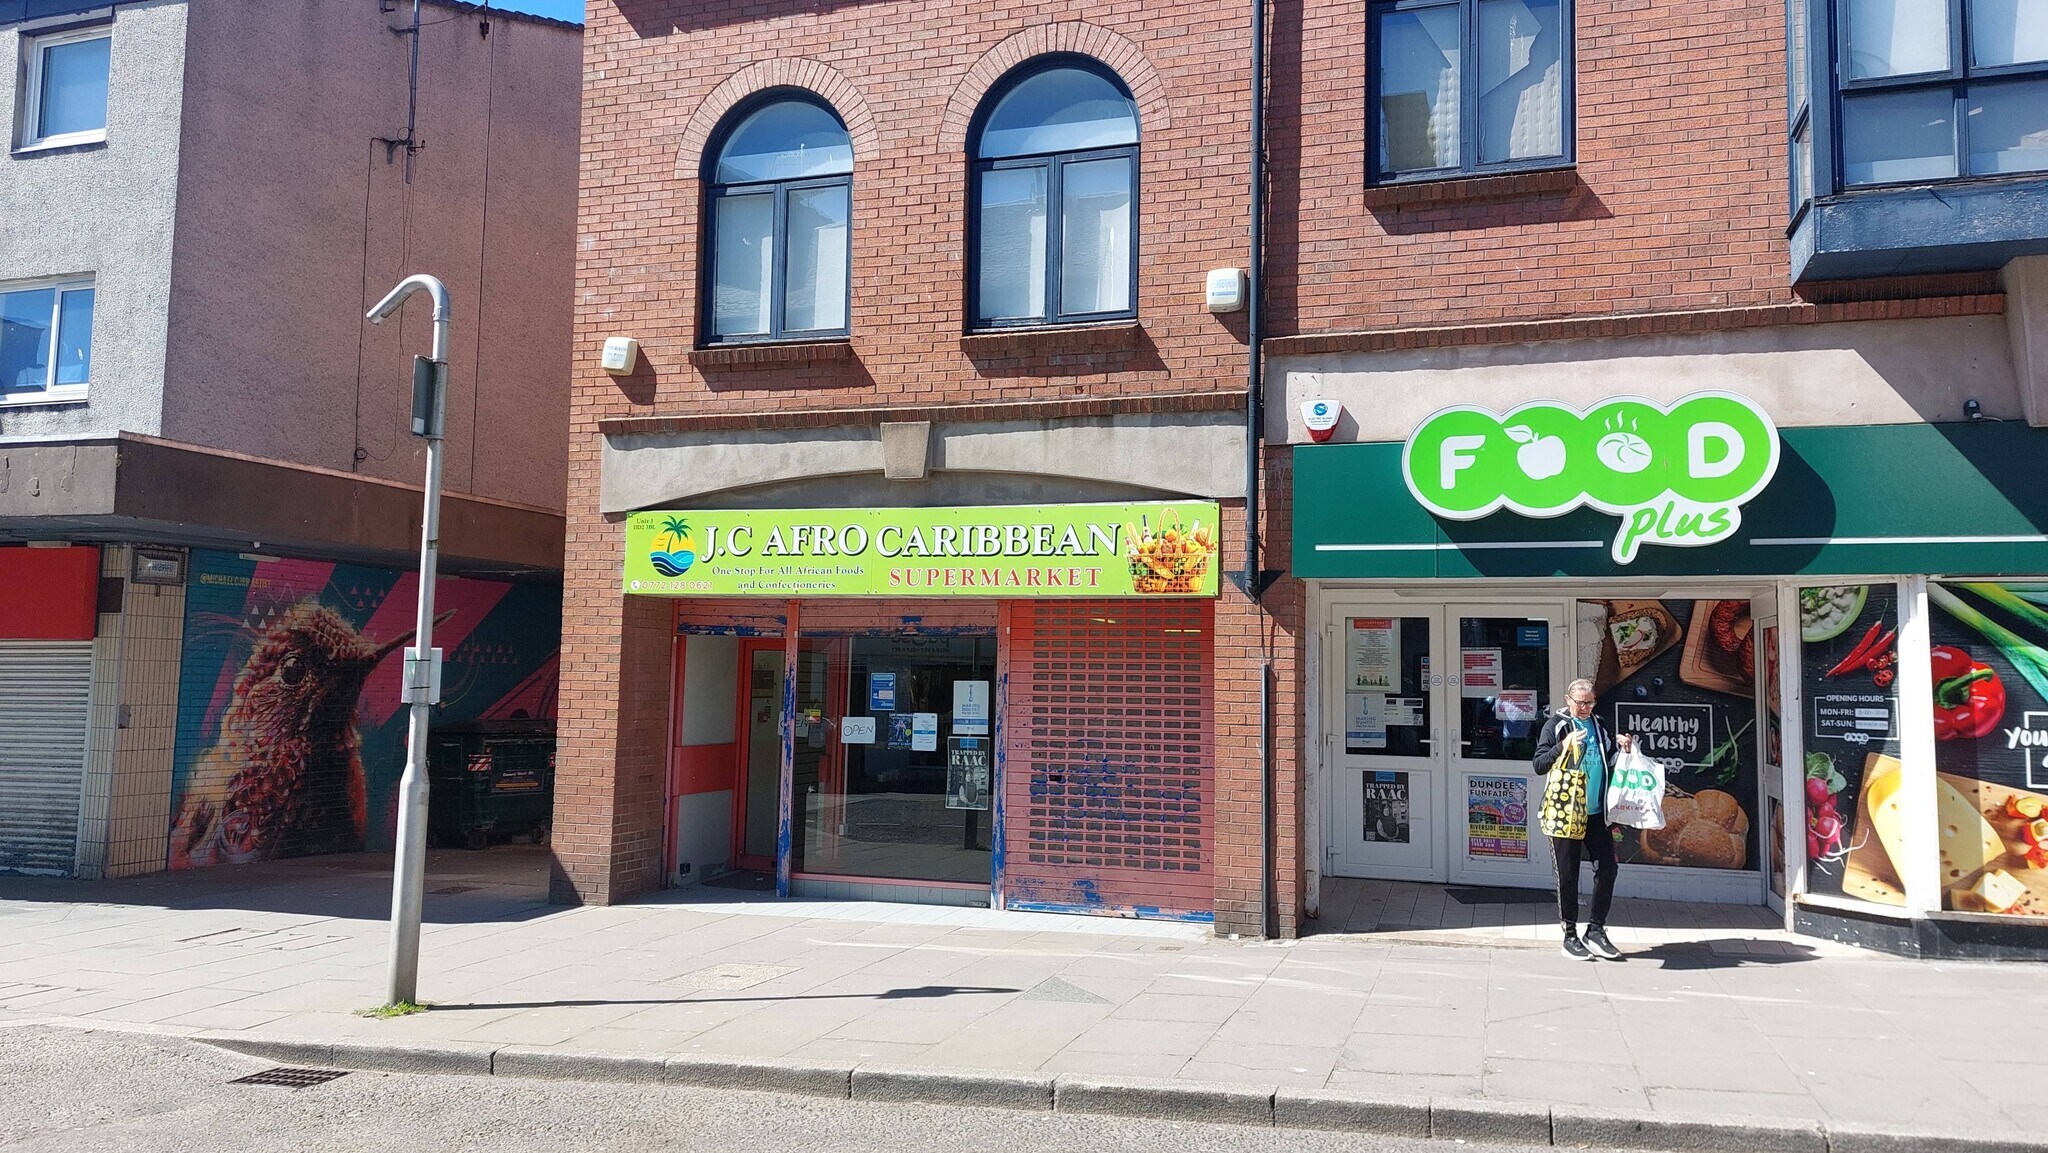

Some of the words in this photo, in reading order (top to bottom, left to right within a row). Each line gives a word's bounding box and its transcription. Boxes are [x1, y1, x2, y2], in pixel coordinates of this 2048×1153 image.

[1622, 500, 1731, 558] plus
[701, 526, 752, 563] J.C
[762, 524, 869, 557] AFRO
[875, 523, 1121, 558] CARIBBEAN
[712, 565, 731, 576] One
[734, 565, 756, 577] Stop
[759, 565, 774, 575] For
[777, 565, 792, 575] All
[796, 564, 832, 575] African
[835, 564, 864, 575] Foods
[888, 567, 1102, 588] SUPERMARKET
[642, 581, 667, 590] 0772
[670, 581, 686, 590] 128
[738, 580, 755, 589] and
[758, 580, 836, 589] Confectioneries
[1820, 708, 1854, 716] MON-FRI:
[843, 724, 874, 737] OPEN
[1628, 714, 1699, 735] Healthy
[1645, 732, 1698, 752] Tasty
[951, 755, 987, 767] RAAC
[1470, 780, 1515, 790] DUNDEE
[1366, 789, 1406, 800] RAAC
